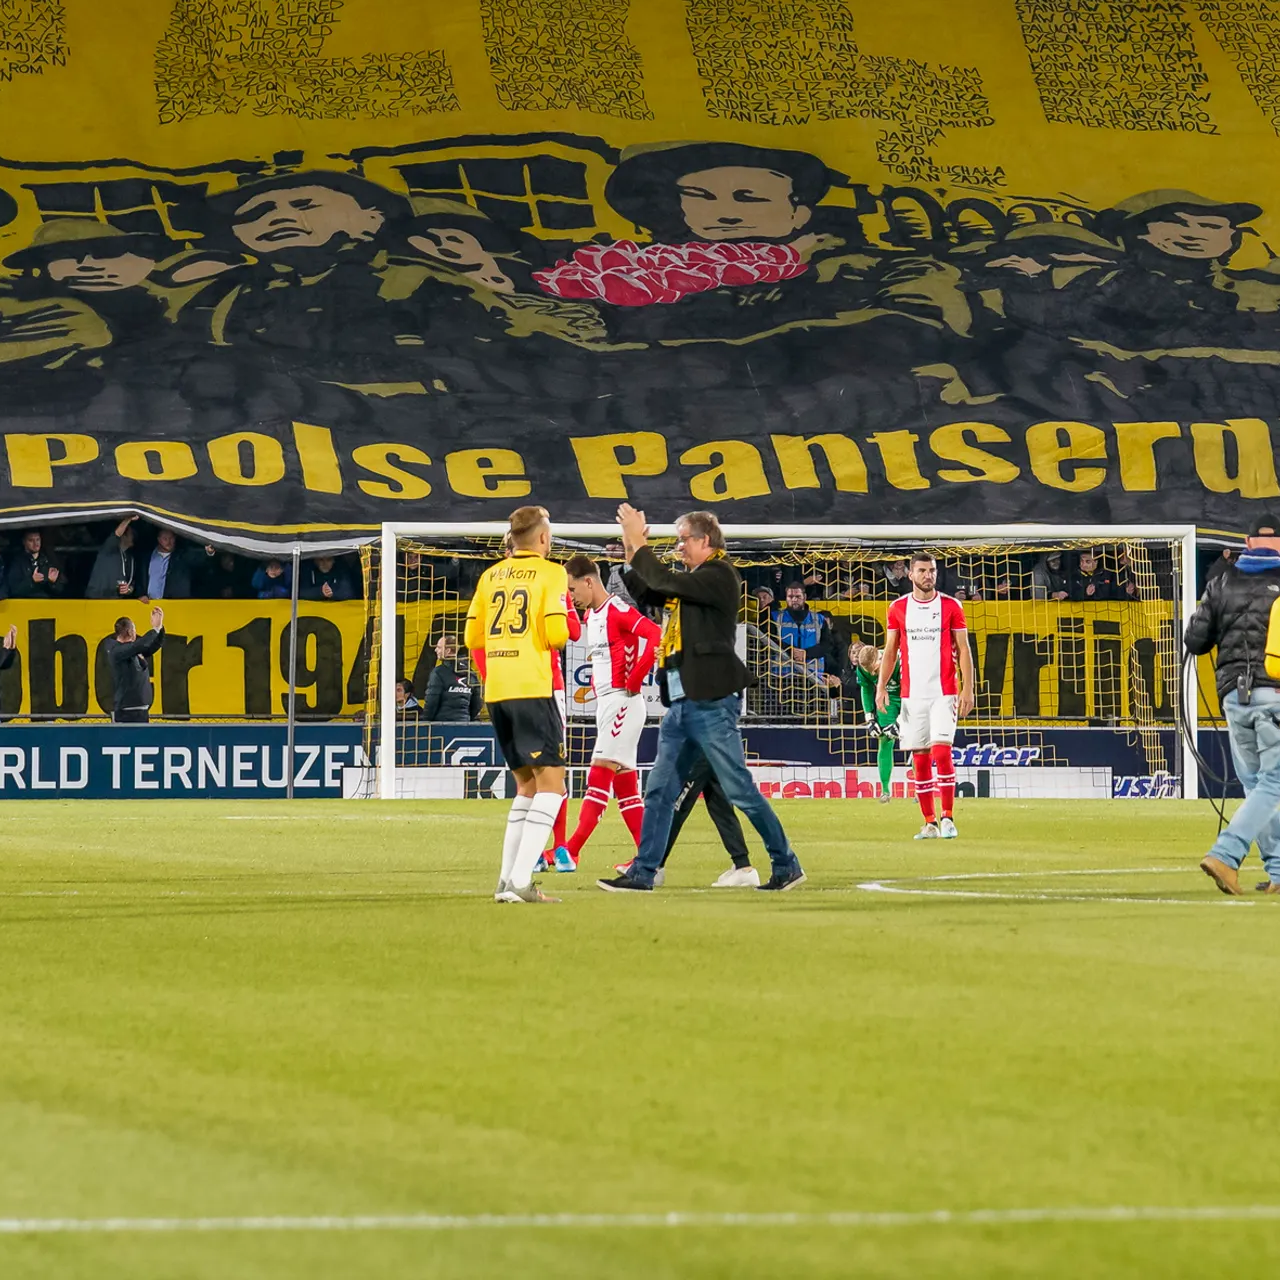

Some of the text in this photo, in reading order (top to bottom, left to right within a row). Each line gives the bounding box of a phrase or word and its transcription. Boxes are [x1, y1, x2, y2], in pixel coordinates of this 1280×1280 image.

[276, 0, 344, 12] ALFRED
[250, 25, 333, 40] LEOPOLD
[707, 108, 810, 126] STANISŁAW
[5, 421, 532, 500] Poolse
[489, 586, 530, 637] 23
[912, 743, 1040, 768] etter
